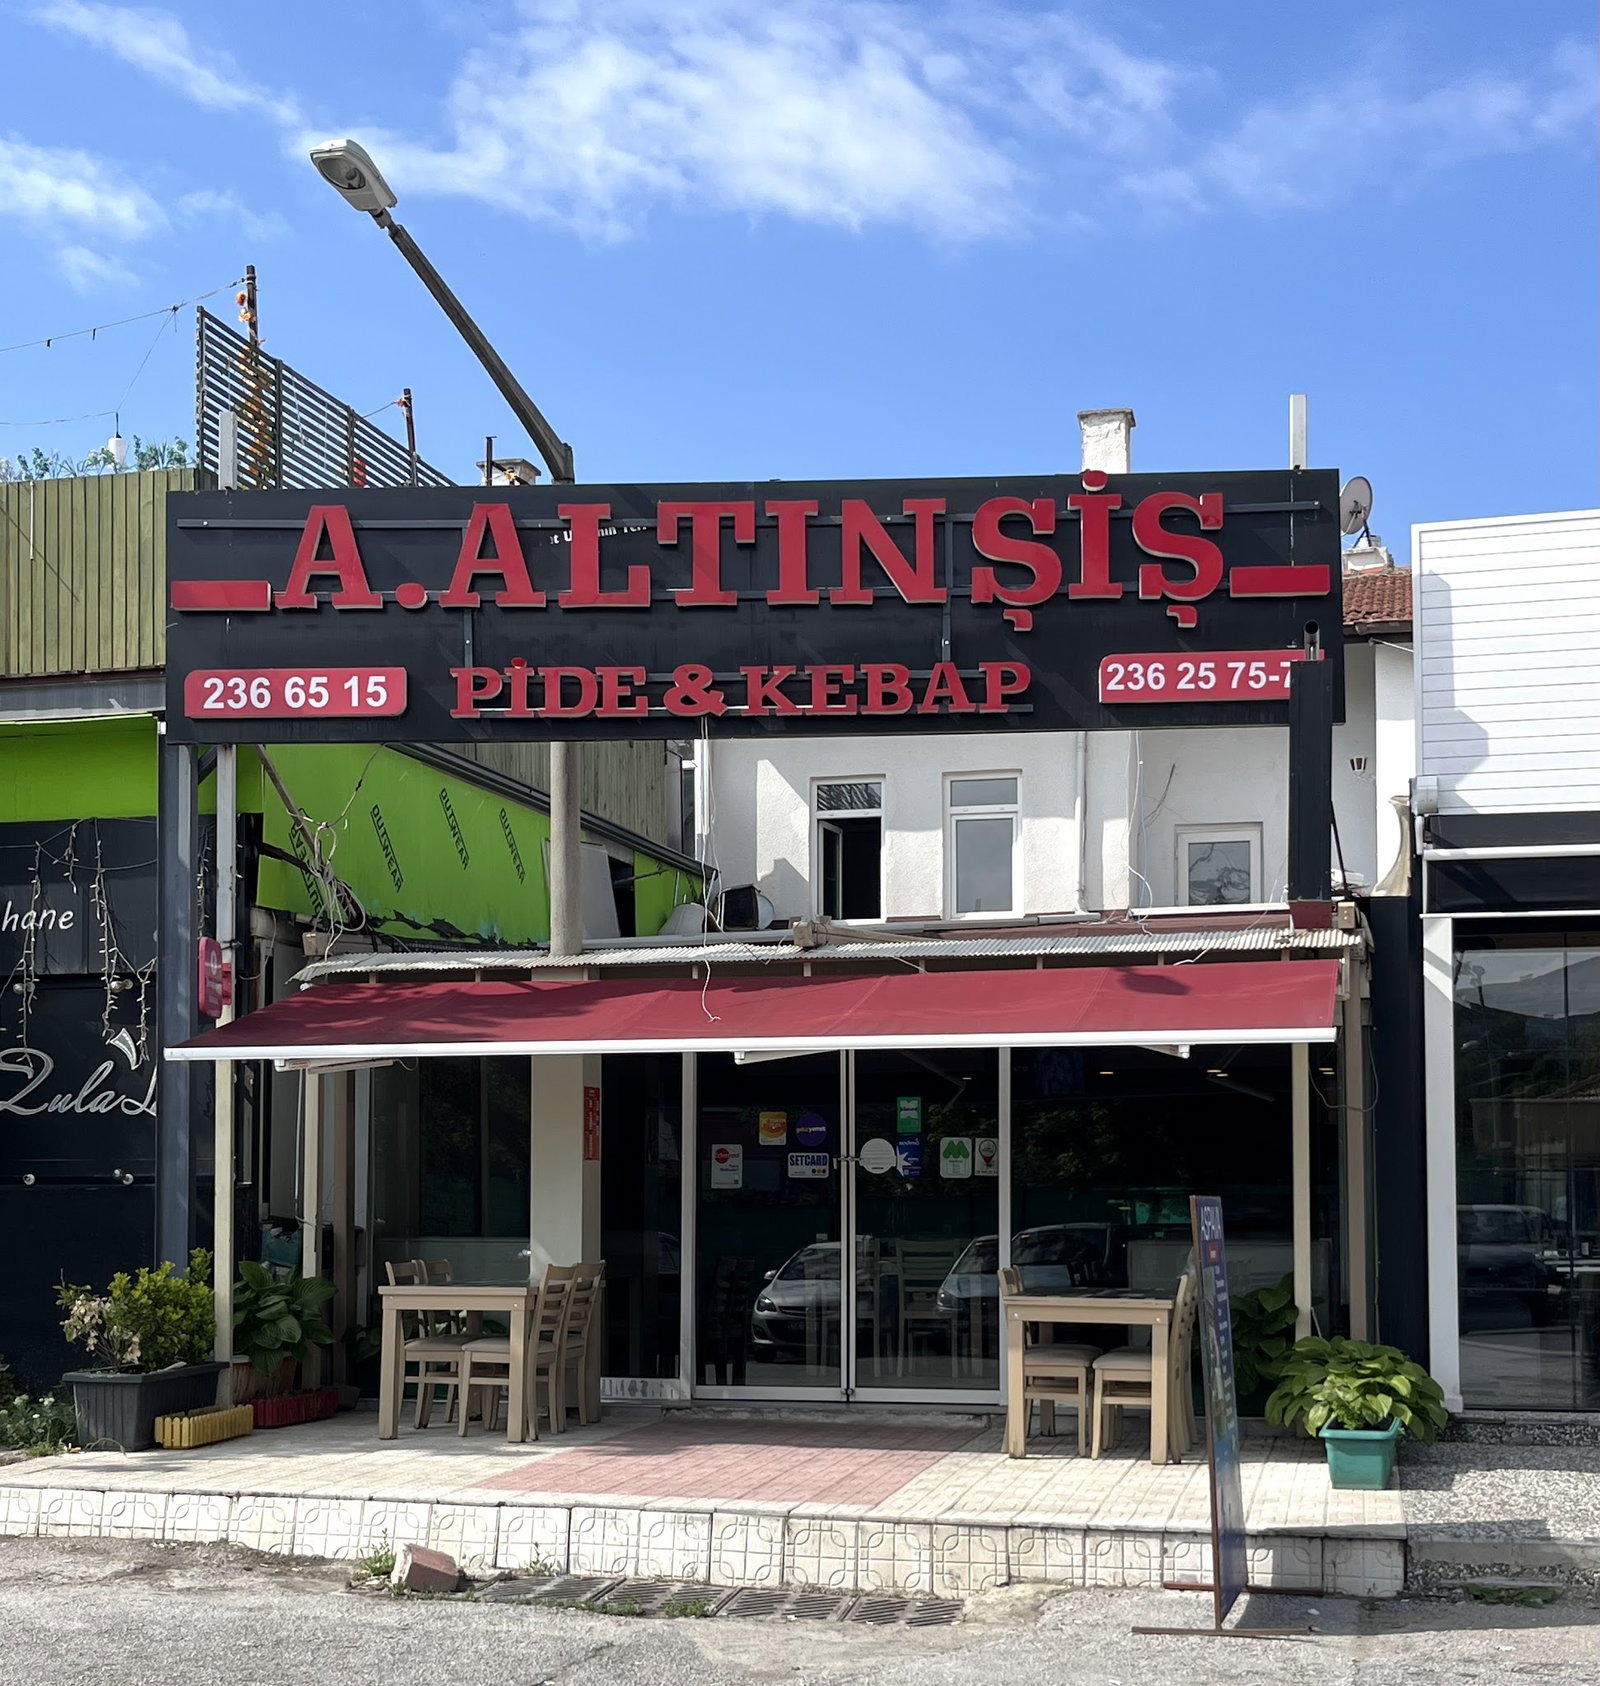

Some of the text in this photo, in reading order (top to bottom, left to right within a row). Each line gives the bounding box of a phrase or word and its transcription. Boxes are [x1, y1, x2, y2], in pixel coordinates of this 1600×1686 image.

[1106, 662, 1166, 690] 236
[1176, 662, 1216, 690] 25
[203, 675, 388, 709] 236 65 15
[370, 804, 404, 893] OUTWEAR
[789, 1154, 828, 1167] SETCARD
